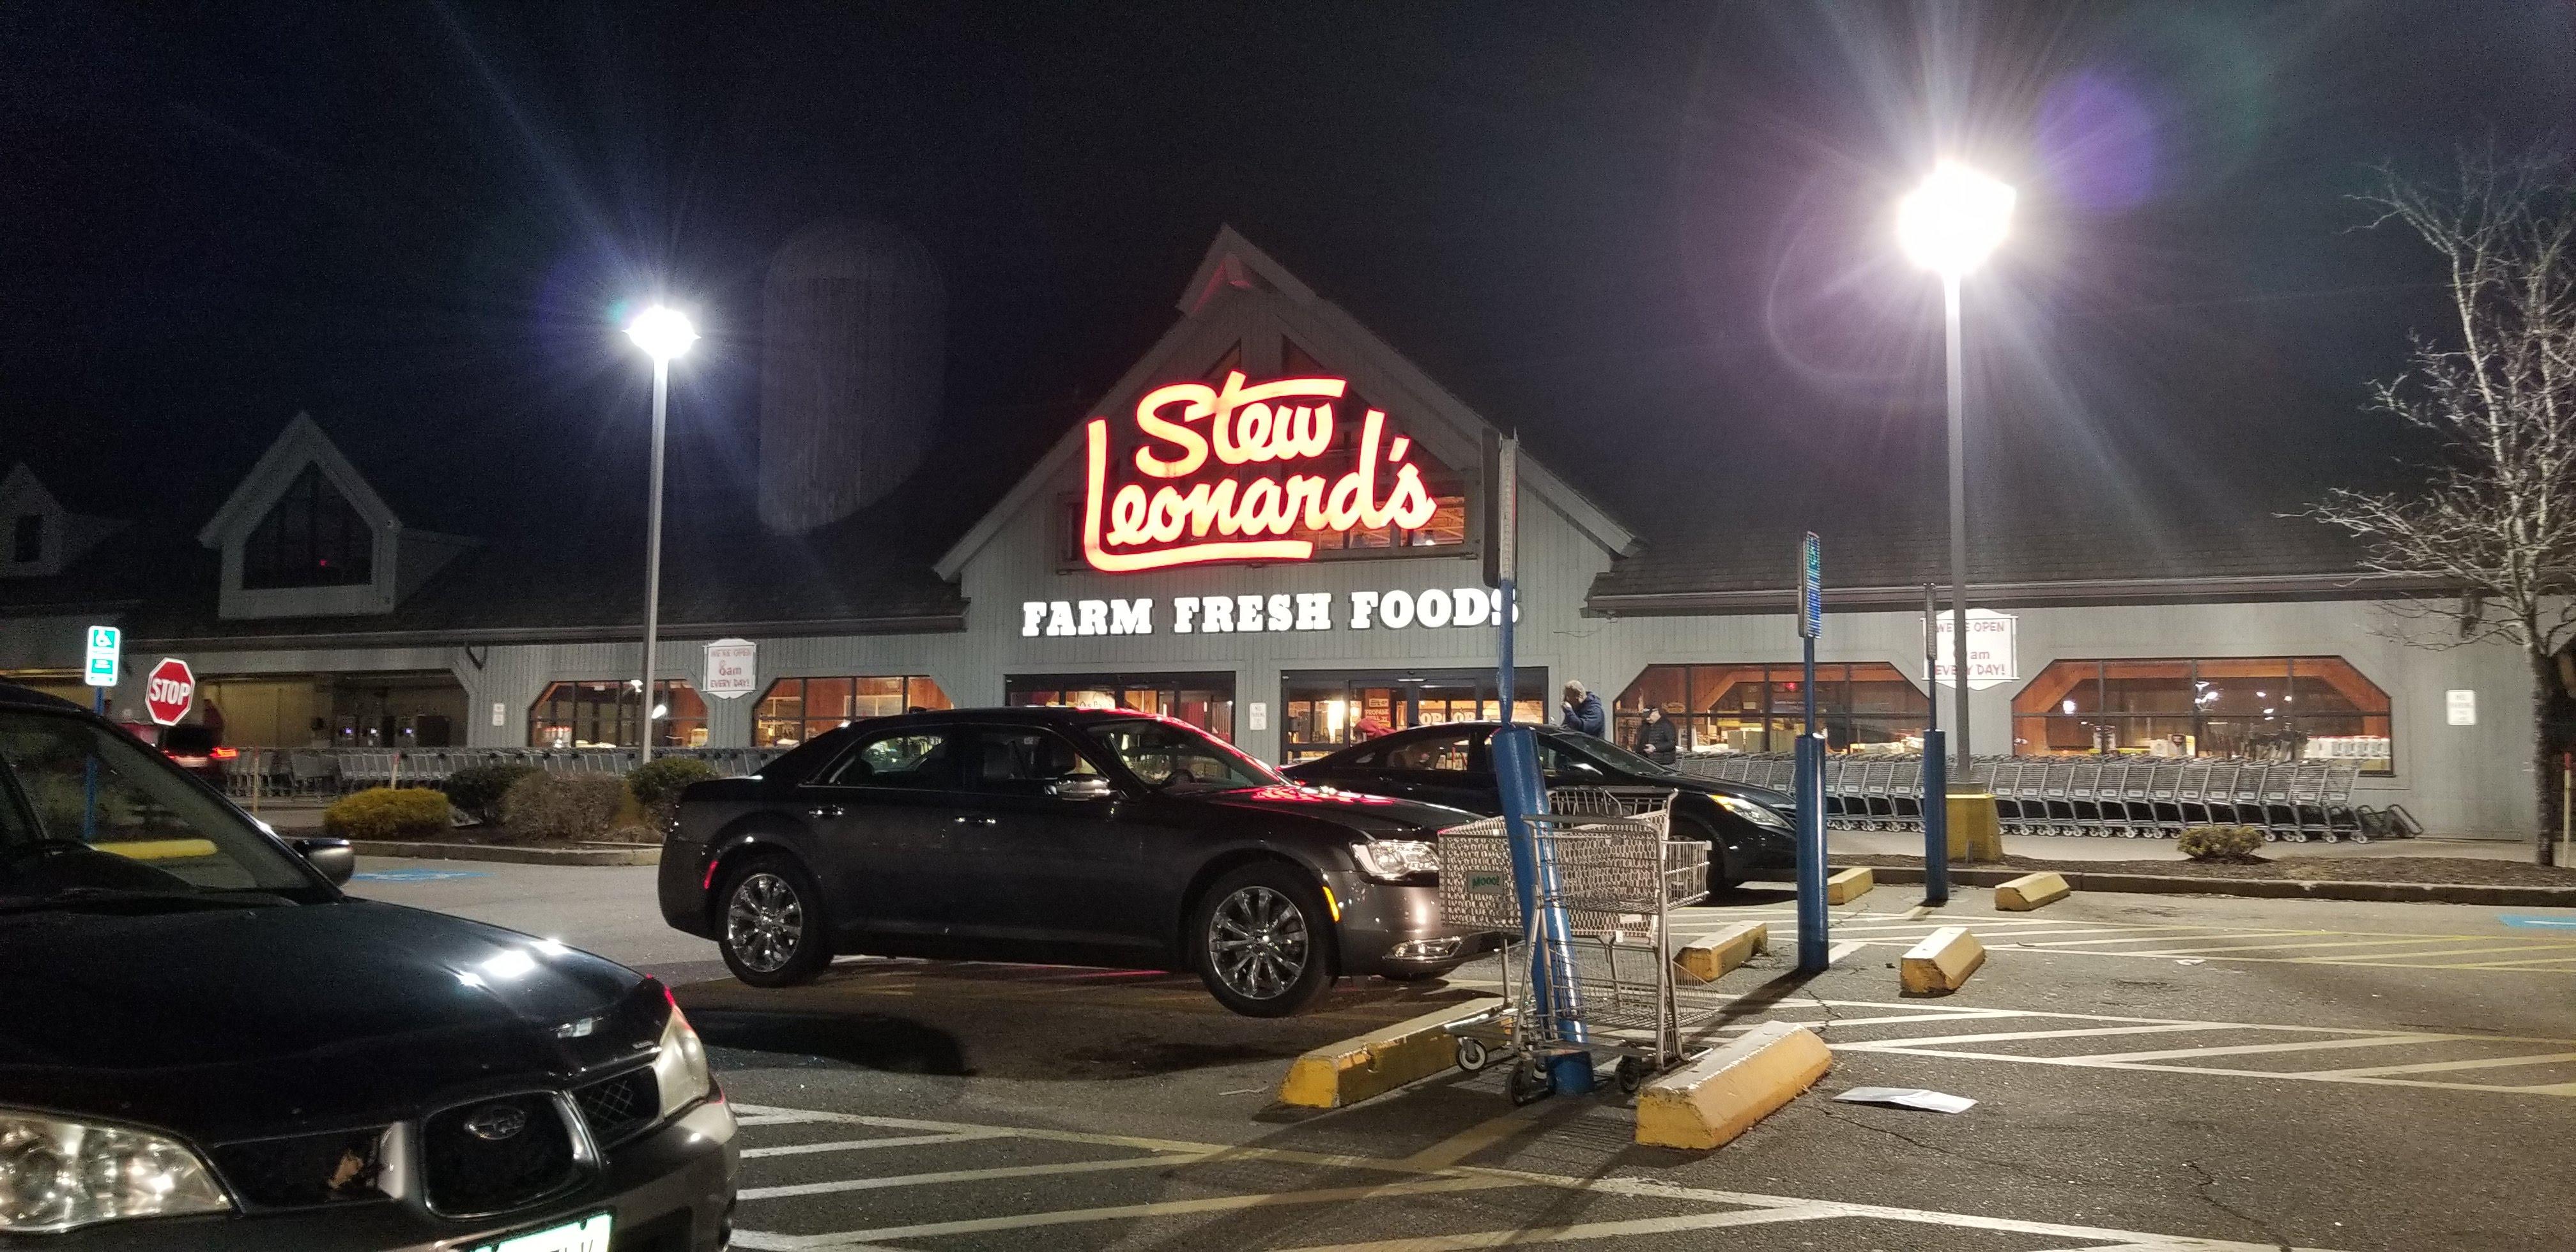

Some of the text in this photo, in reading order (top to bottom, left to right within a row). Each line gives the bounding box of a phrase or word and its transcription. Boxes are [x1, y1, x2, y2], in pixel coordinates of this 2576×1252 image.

[1135, 369, 1347, 478] Stew
[1083, 407, 1439, 572] Leonard's
[1022, 587, 1520, 637] FARM FRESH FOODS
[1974, 621, 2005, 632] OPEN
[1935, 664, 2005, 676] EVEY DAY!
[150, 678, 191, 706] STOP
